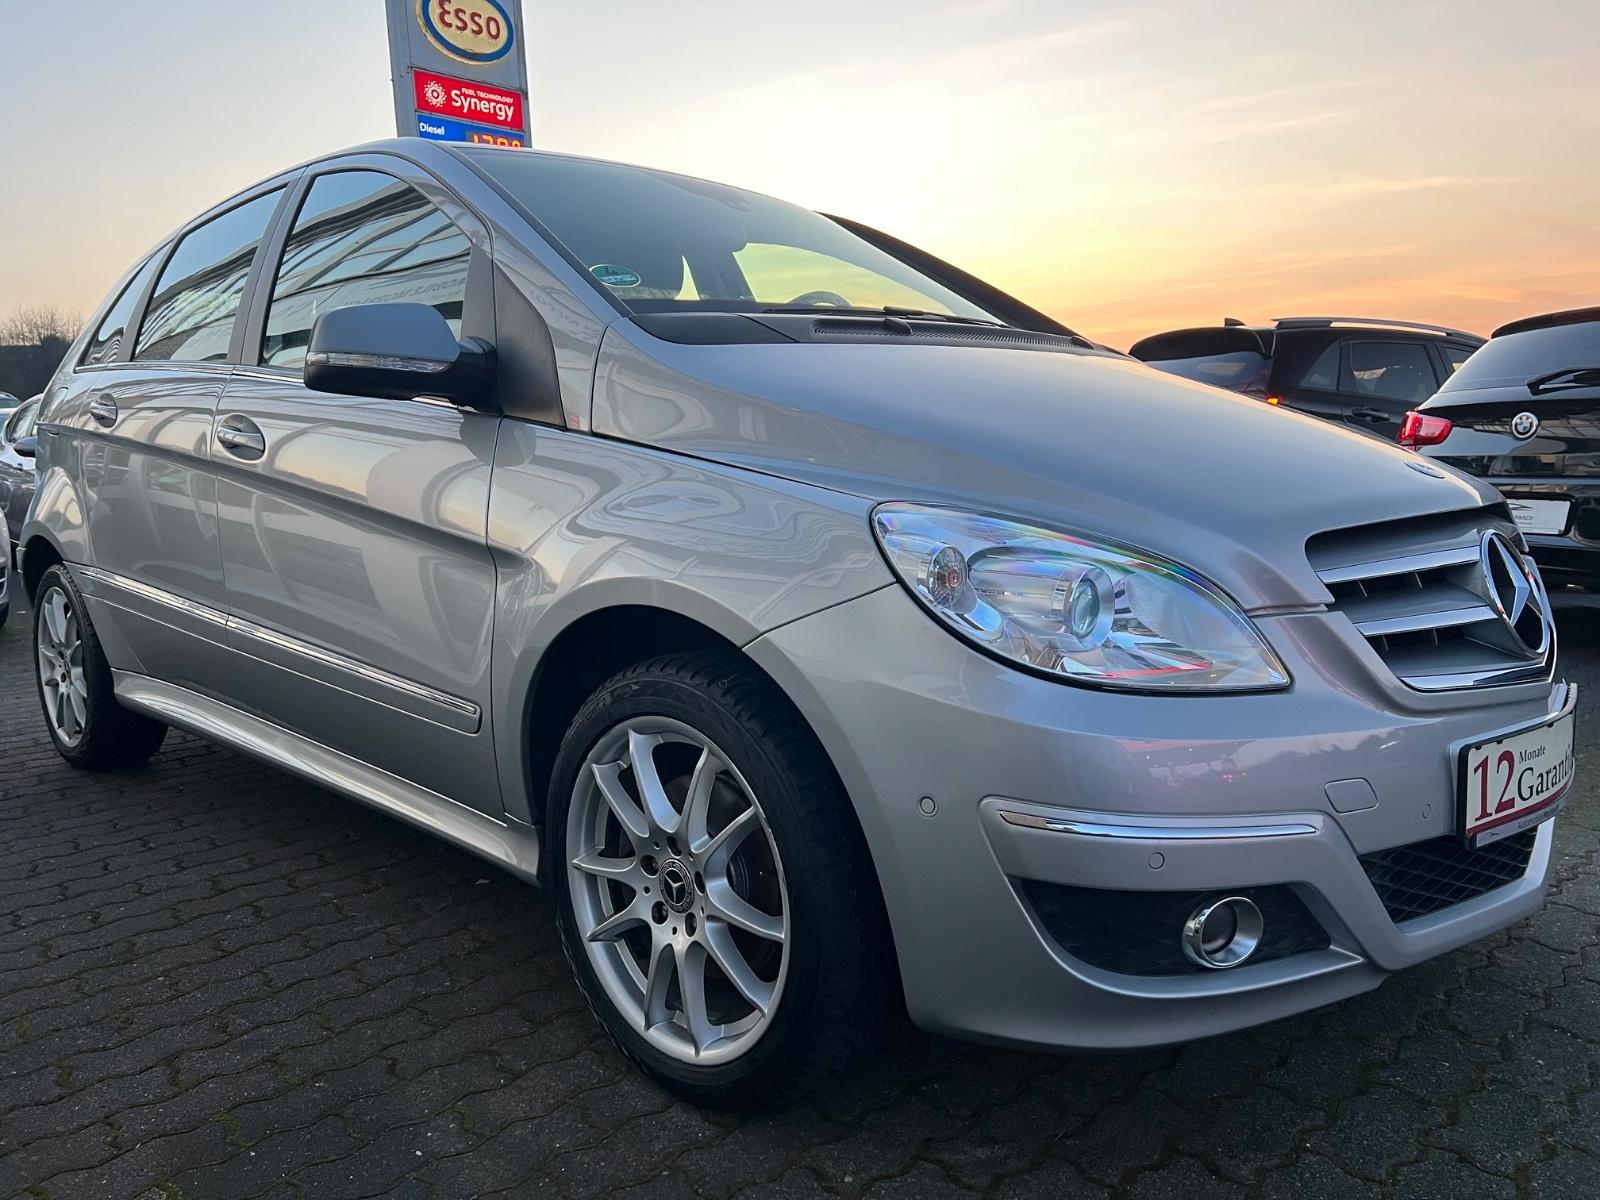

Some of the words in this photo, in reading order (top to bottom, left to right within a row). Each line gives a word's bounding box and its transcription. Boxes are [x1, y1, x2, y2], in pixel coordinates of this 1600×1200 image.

[450, 89, 515, 122] Synergy
[461, 87, 476, 97] FUEL
[476, 90, 514, 105] TECHNOLOGY
[419, 122, 445, 136] Diesel
[1518, 744, 1547, 766] Monate
[1473, 749, 1516, 823] 12
